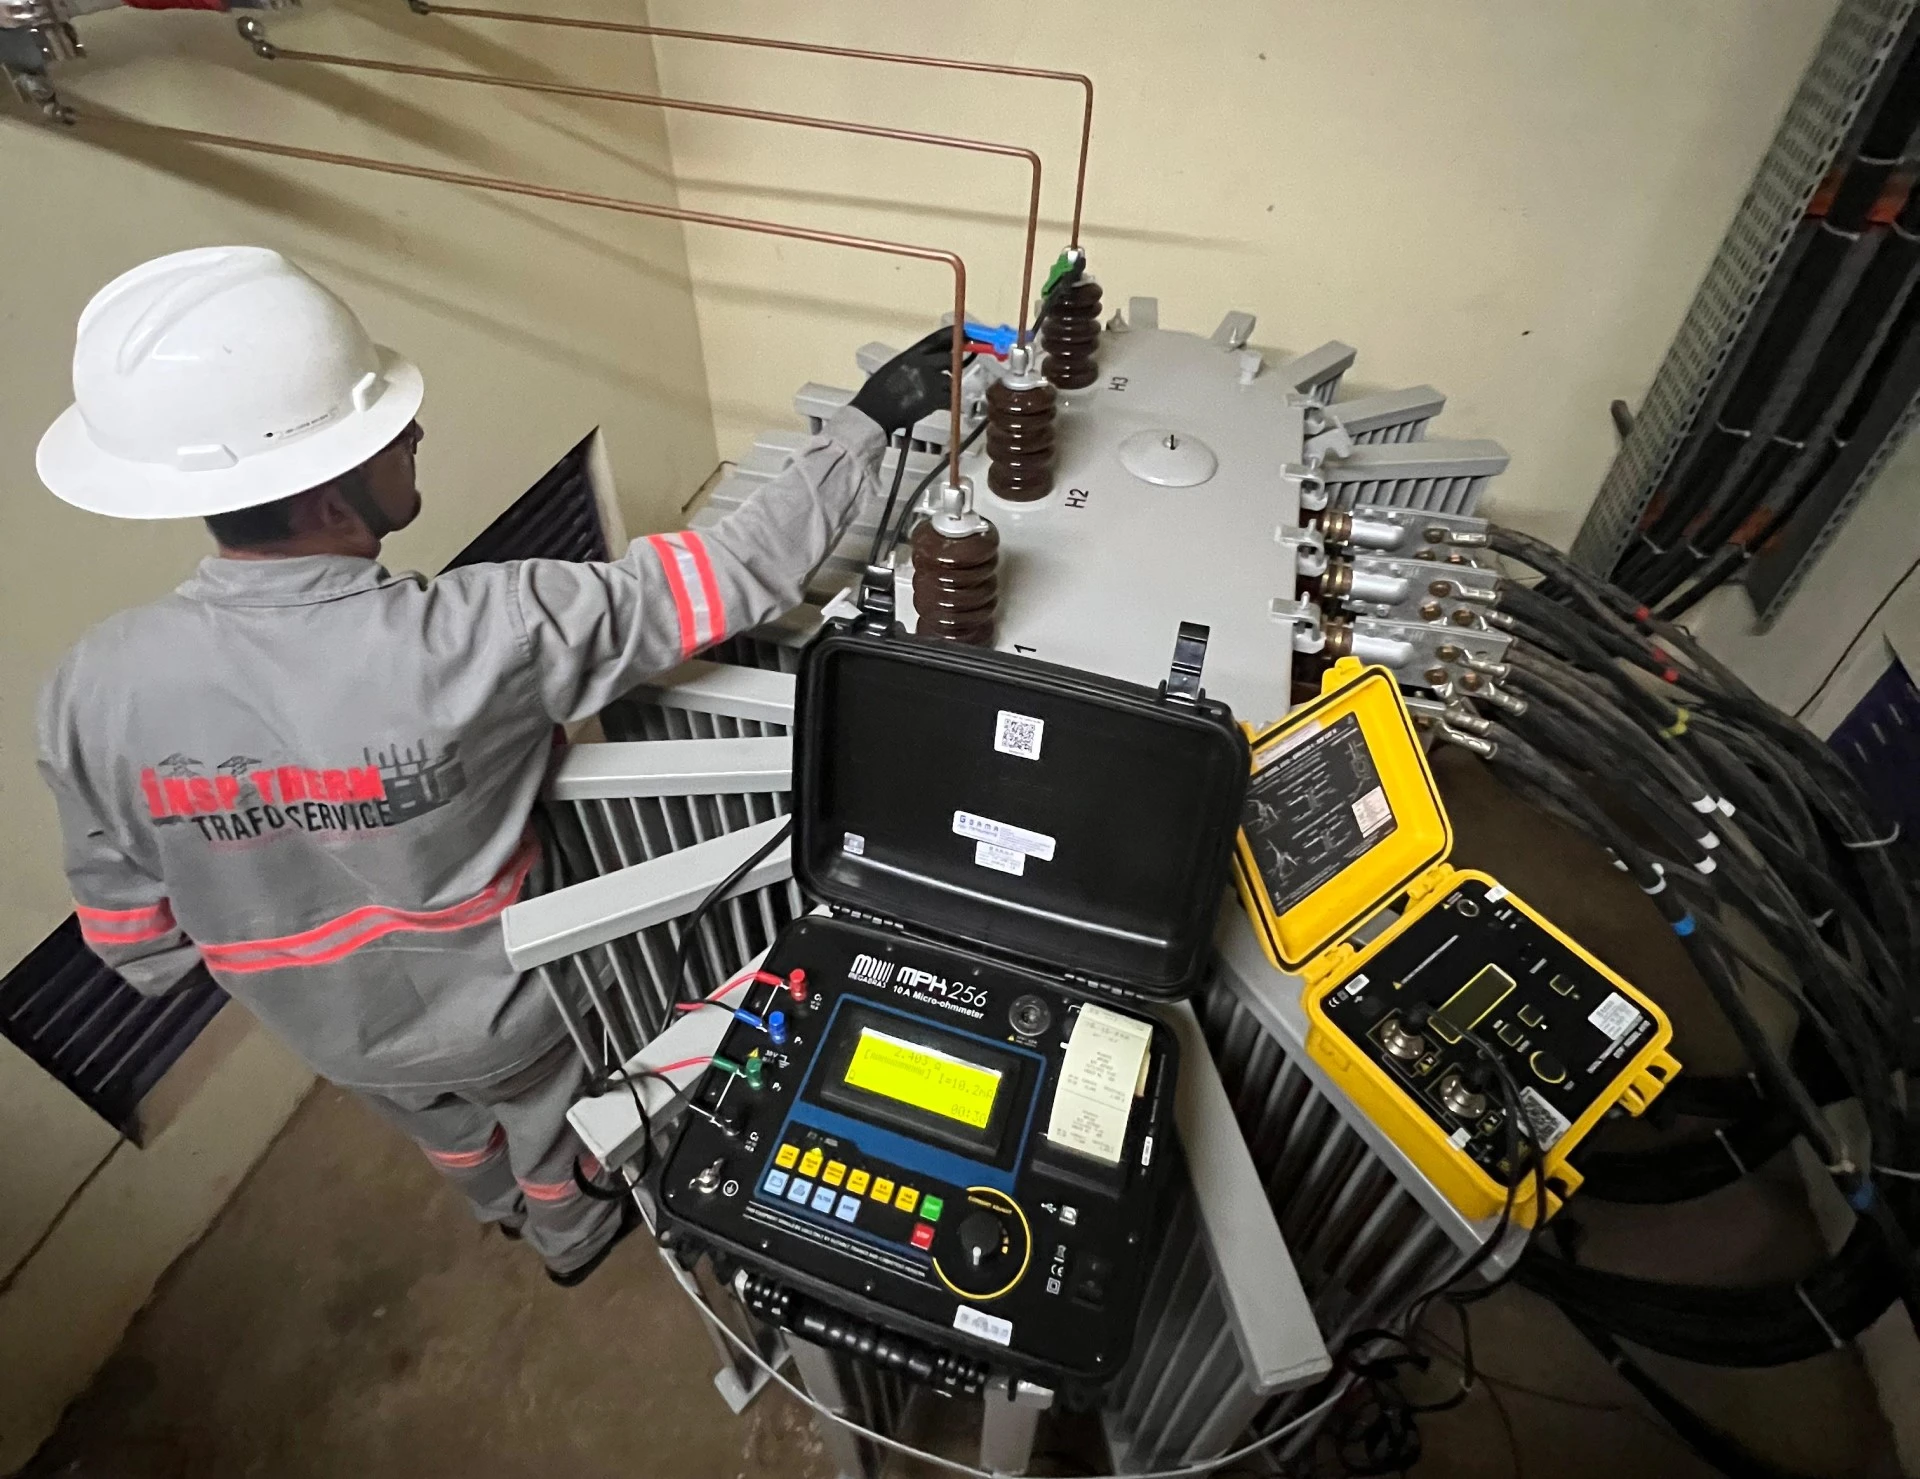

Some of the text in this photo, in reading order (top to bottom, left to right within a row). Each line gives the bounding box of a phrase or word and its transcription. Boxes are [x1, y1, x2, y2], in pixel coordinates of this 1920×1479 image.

[1108, 376, 1129, 392] H3
[1064, 488, 1089, 509] H2
[896, 965, 988, 1008] MPK 256
[912, 991, 984, 1020] Micro-ohmmeter
